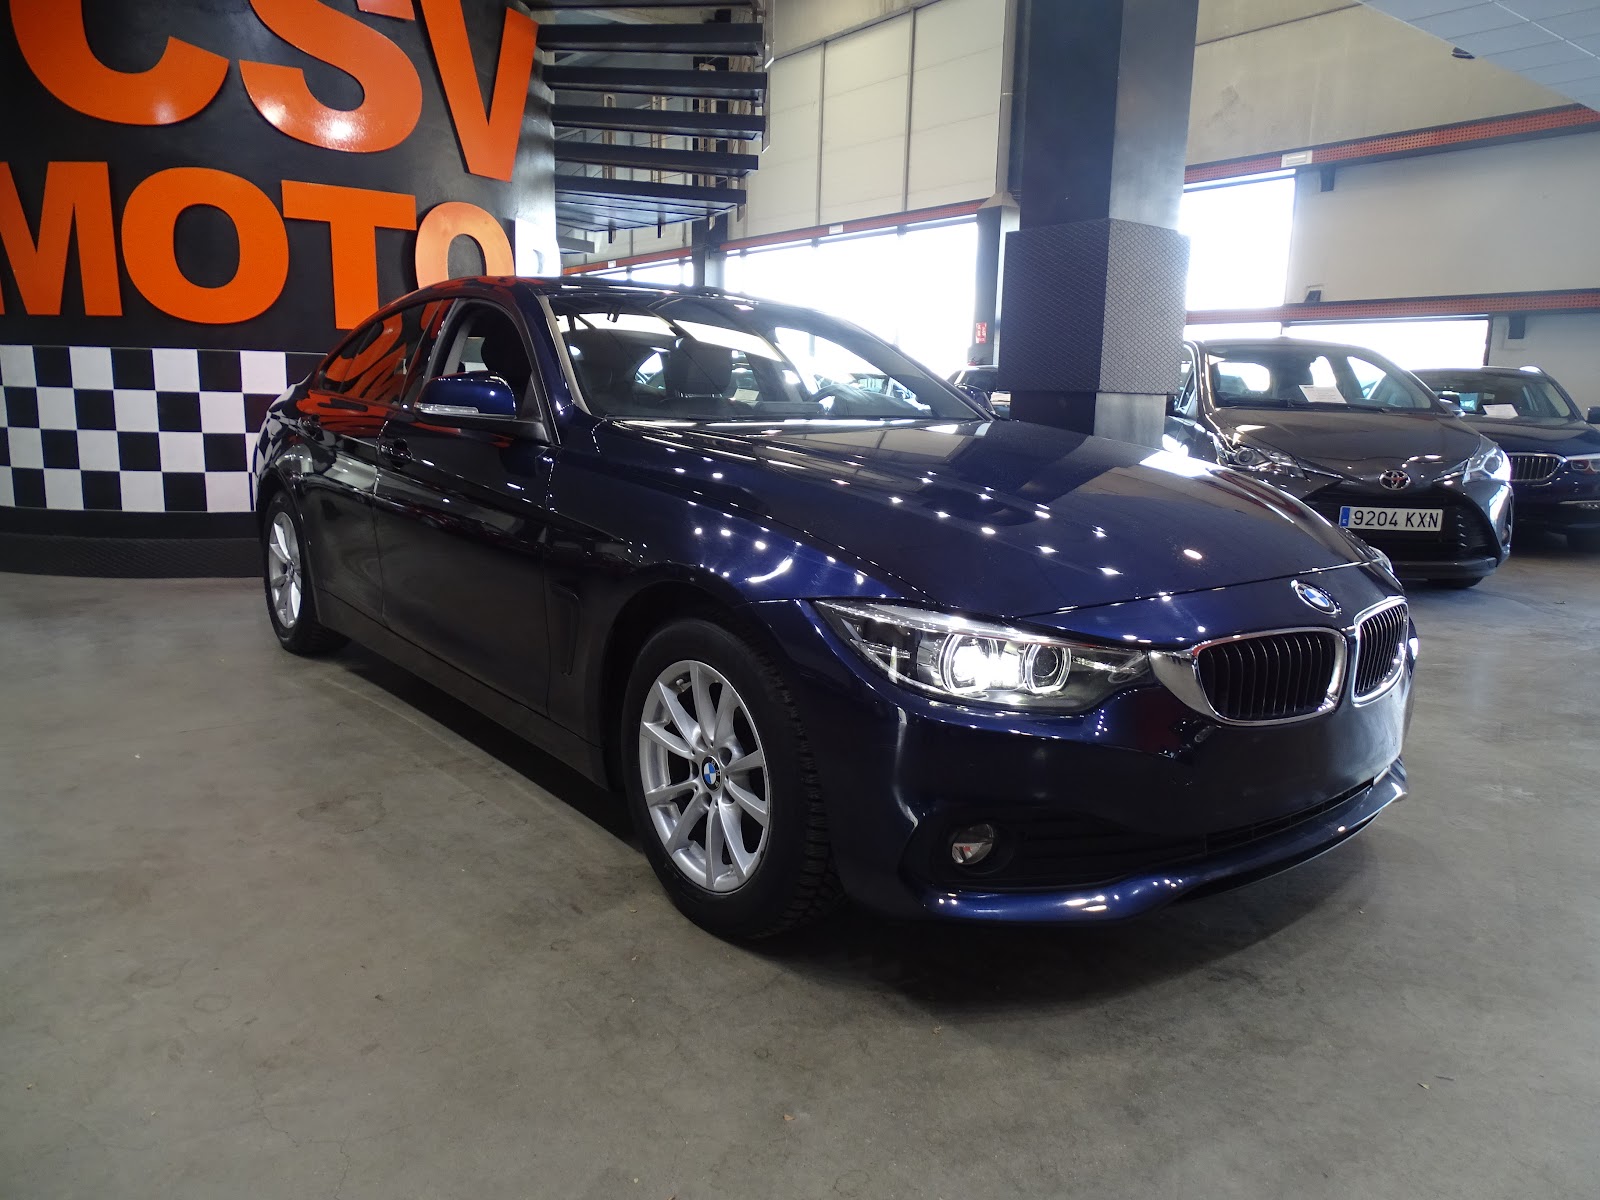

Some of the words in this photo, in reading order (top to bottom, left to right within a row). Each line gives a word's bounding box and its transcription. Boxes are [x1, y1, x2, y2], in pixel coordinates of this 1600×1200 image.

[9, 0, 539, 182] CSV
[1353, 510, 1398, 527] 9204
[1405, 511, 1439, 528] KXN
